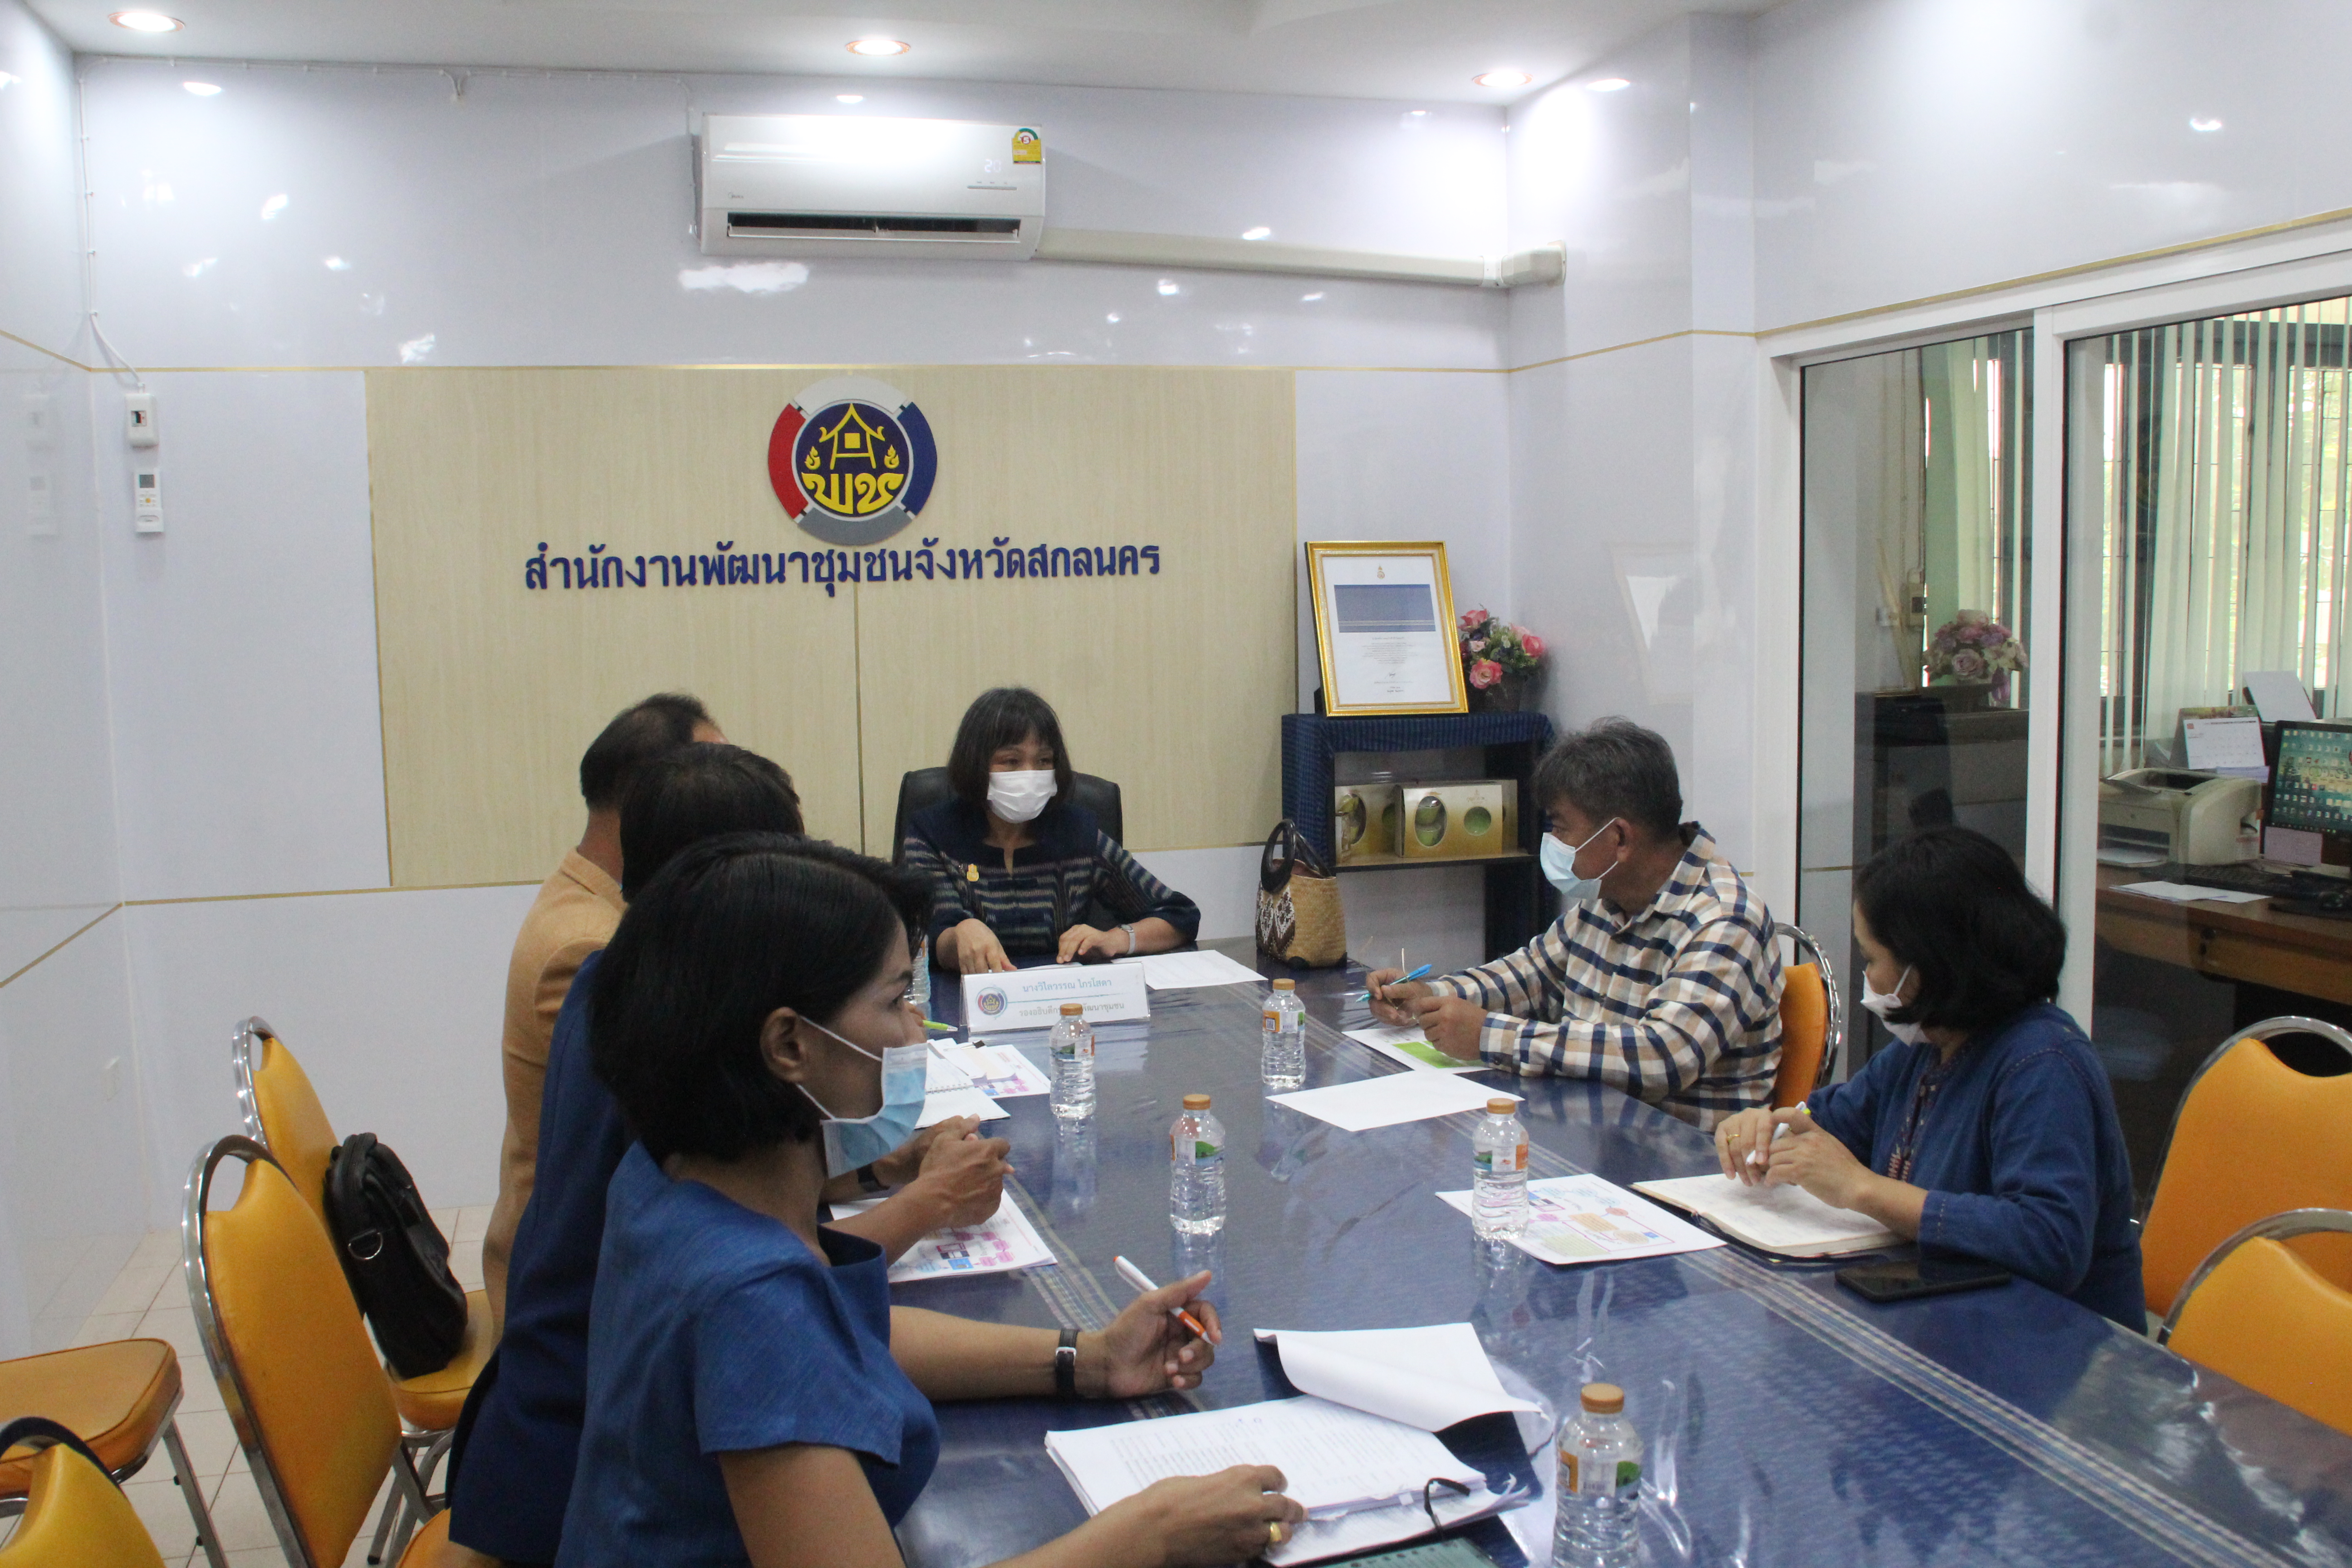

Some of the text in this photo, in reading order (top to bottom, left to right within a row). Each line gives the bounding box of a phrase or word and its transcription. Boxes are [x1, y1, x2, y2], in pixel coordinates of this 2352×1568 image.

[525, 537, 1160, 597] สำนักงานพัฒนาชุมชนจังหวัดสกลนคร
